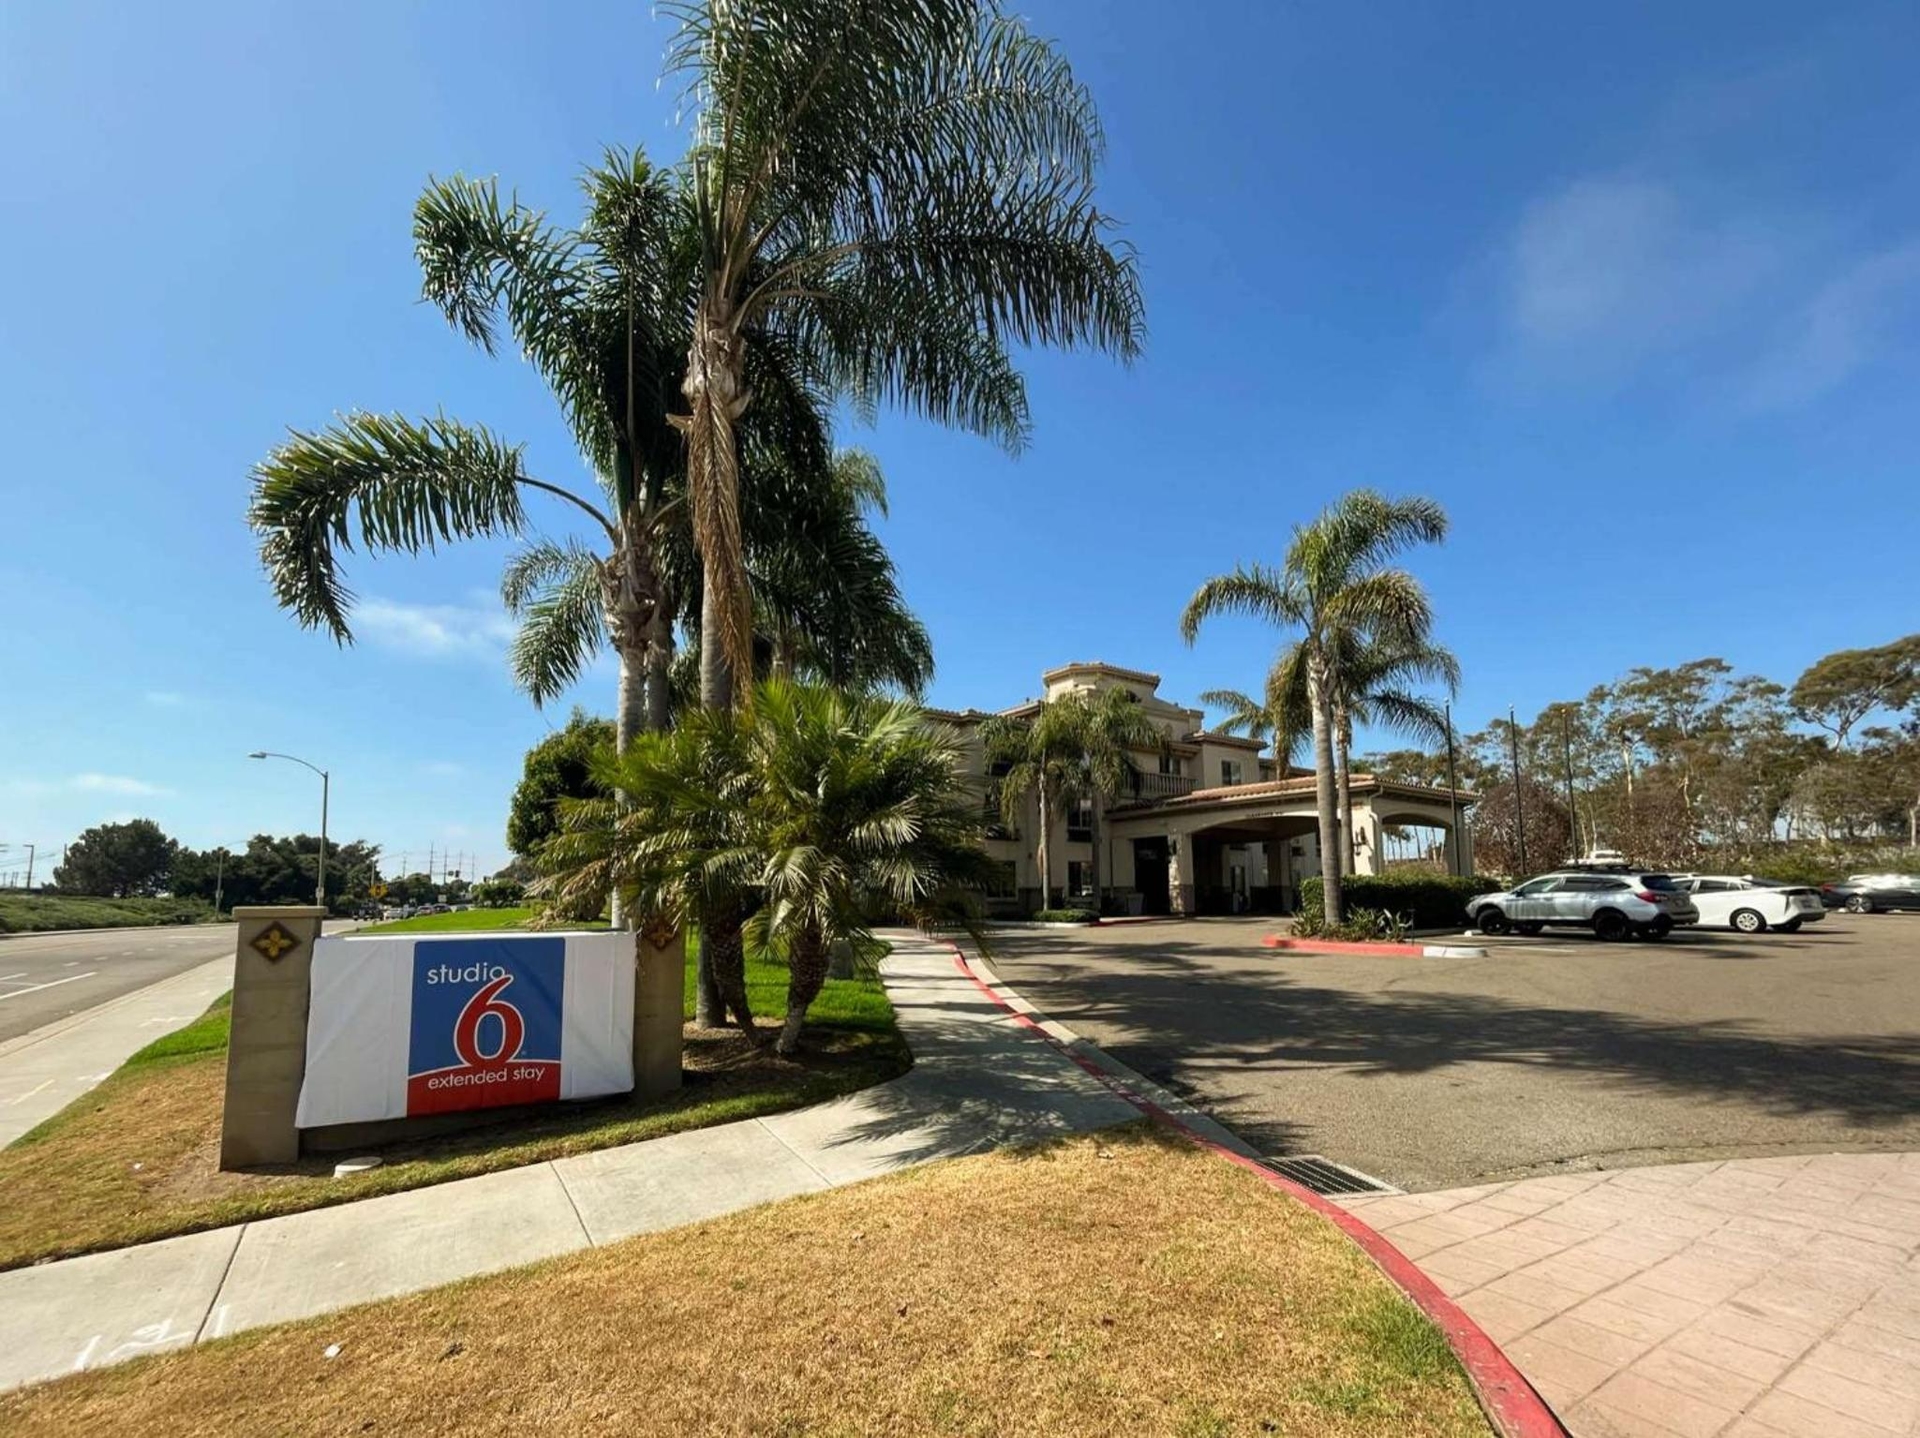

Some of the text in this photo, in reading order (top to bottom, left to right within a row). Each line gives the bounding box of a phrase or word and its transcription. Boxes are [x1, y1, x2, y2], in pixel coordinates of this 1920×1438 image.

[427, 962, 505, 985] studio
[453, 974, 525, 1067] 6
[428, 1066, 545, 1090] extended stay
